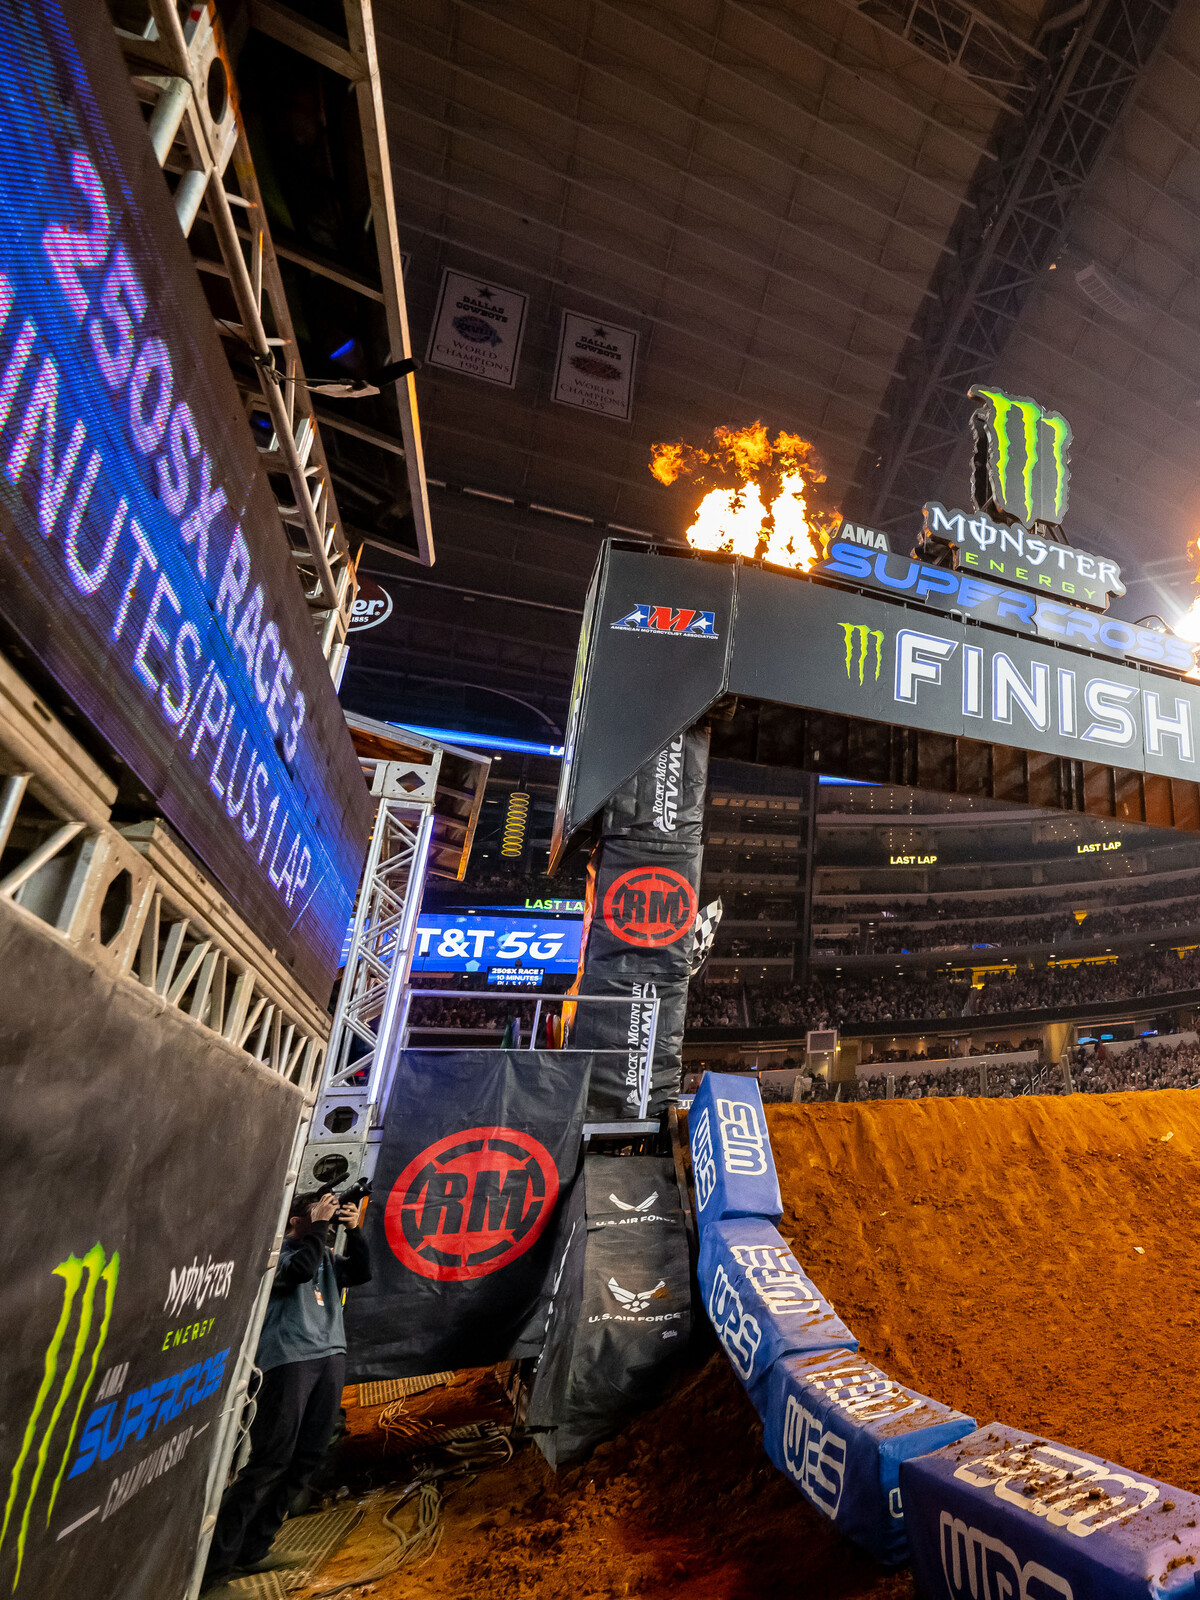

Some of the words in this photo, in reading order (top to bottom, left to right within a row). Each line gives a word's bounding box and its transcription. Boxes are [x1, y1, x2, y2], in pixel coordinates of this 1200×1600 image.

[455, 301, 508, 323] COWBOYS
[462, 295, 505, 314] DALLAS
[436, 343, 510, 374] CHAMPIONS
[453, 339, 498, 360] WORLD
[574, 341, 622, 360] COWBOYS
[580, 335, 619, 352] DALLAS
[459, 361, 486, 375] 1993
[559, 383, 627, 409] CHAMPIONS
[574, 378, 615, 396] WORLD
[841, 523, 889, 551] AMA
[931, 506, 1127, 596] MONSTER
[964, 551, 1097, 600] ENERGY
[610, 603, 720, 637] AMA
[823, 542, 1197, 671] SUPERCROSS
[216, 521, 293, 736] RACE
[283, 689, 305, 762] 3
[893, 628, 1196, 763] FINISH
[652, 782, 665, 815] ROCKY
[268, 811, 313, 909] LAP
[890, 856, 916, 865] LAST
[917, 855, 937, 865] LAP
[1077, 843, 1102, 854] LAST
[1102, 841, 1122, 852] LAP
[525, 898, 562, 911] LAST
[496, 932, 566, 960] 5G
[492, 967, 518, 975] 250SX
[506, 974, 540, 982] MINUTES
[717, 1099, 768, 1176] WPS
[692, 1107, 717, 1213] WPS
[619, 1216, 638, 1225] AIR
[163, 1254, 236, 1319] MONSTER
[587, 1313, 613, 1324] U.S.
[614, 1314, 636, 1322] AIR
[638, 1312, 682, 1322] FORCE
[709, 1264, 762, 1381] WPS
[161, 1317, 216, 1352] ENERGY
[94, 1361, 130, 1403] AMA
[67, 1346, 232, 1481] SUPERCROSS
[783, 1393, 847, 1521] WPS
[101, 1424, 194, 1523] CHAMPIONSHIP
